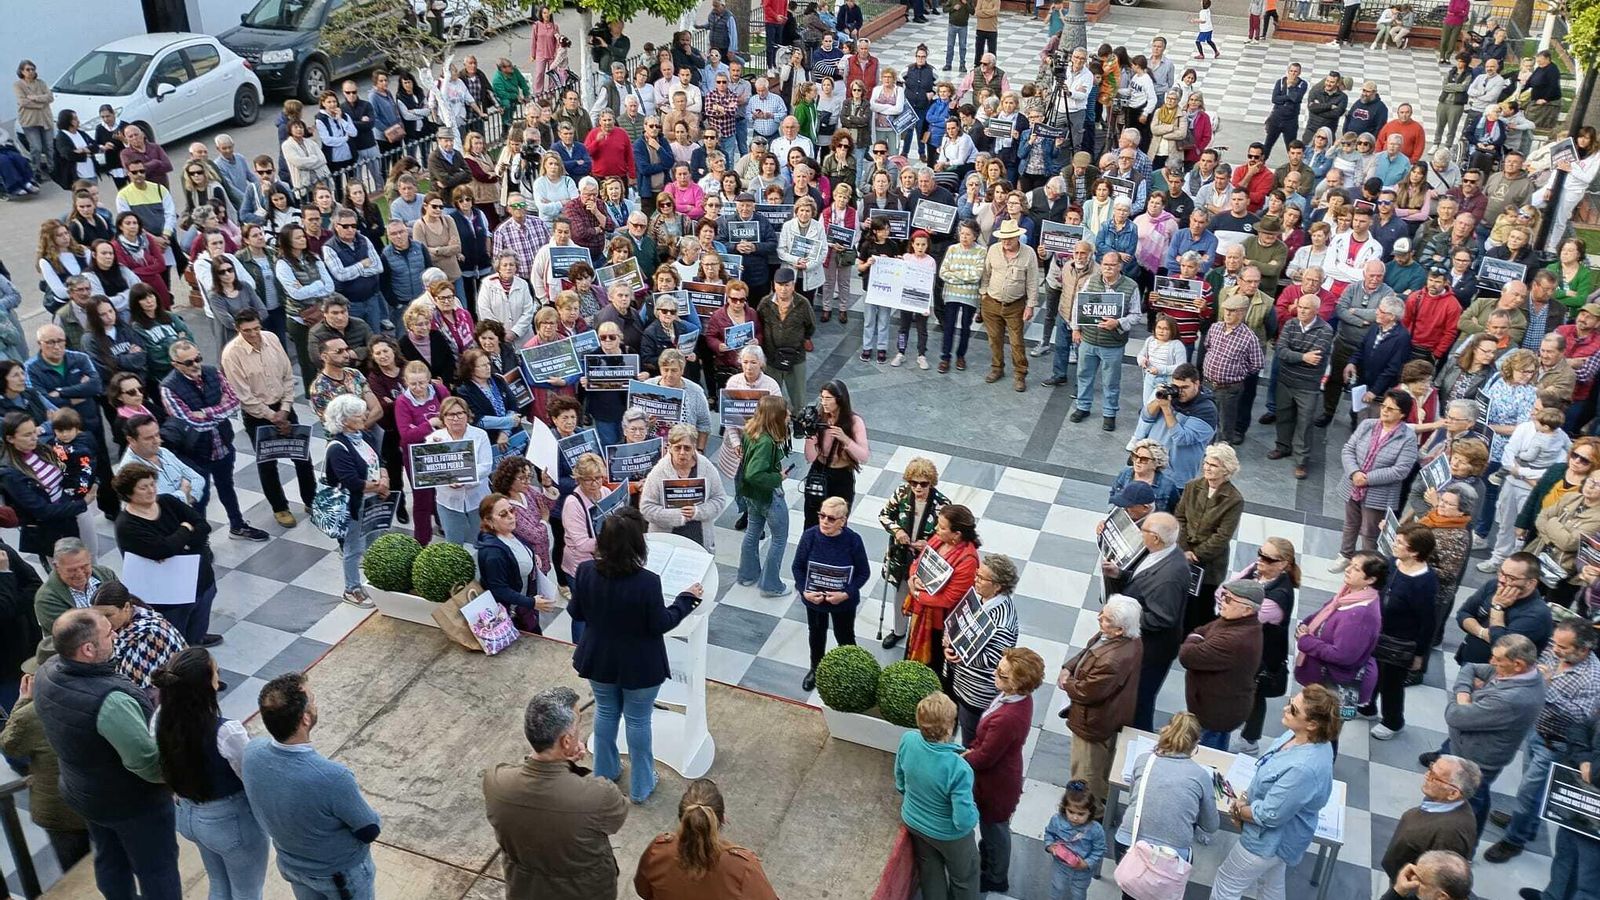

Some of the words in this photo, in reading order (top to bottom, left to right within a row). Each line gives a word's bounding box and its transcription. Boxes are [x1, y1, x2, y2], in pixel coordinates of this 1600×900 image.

[1082, 304, 1092, 315] SE
[424, 455, 433, 464] POR
[434, 455, 439, 463] EL
[439, 453, 457, 462] FUTURO
[457, 453, 464, 461] DE
[633, 455, 651, 464] MOMENTO
[426, 463, 446, 471] NUESTRO
[447, 461, 464, 469] PUEBLO
[1552, 792, 1571, 804] TAMPOCO
